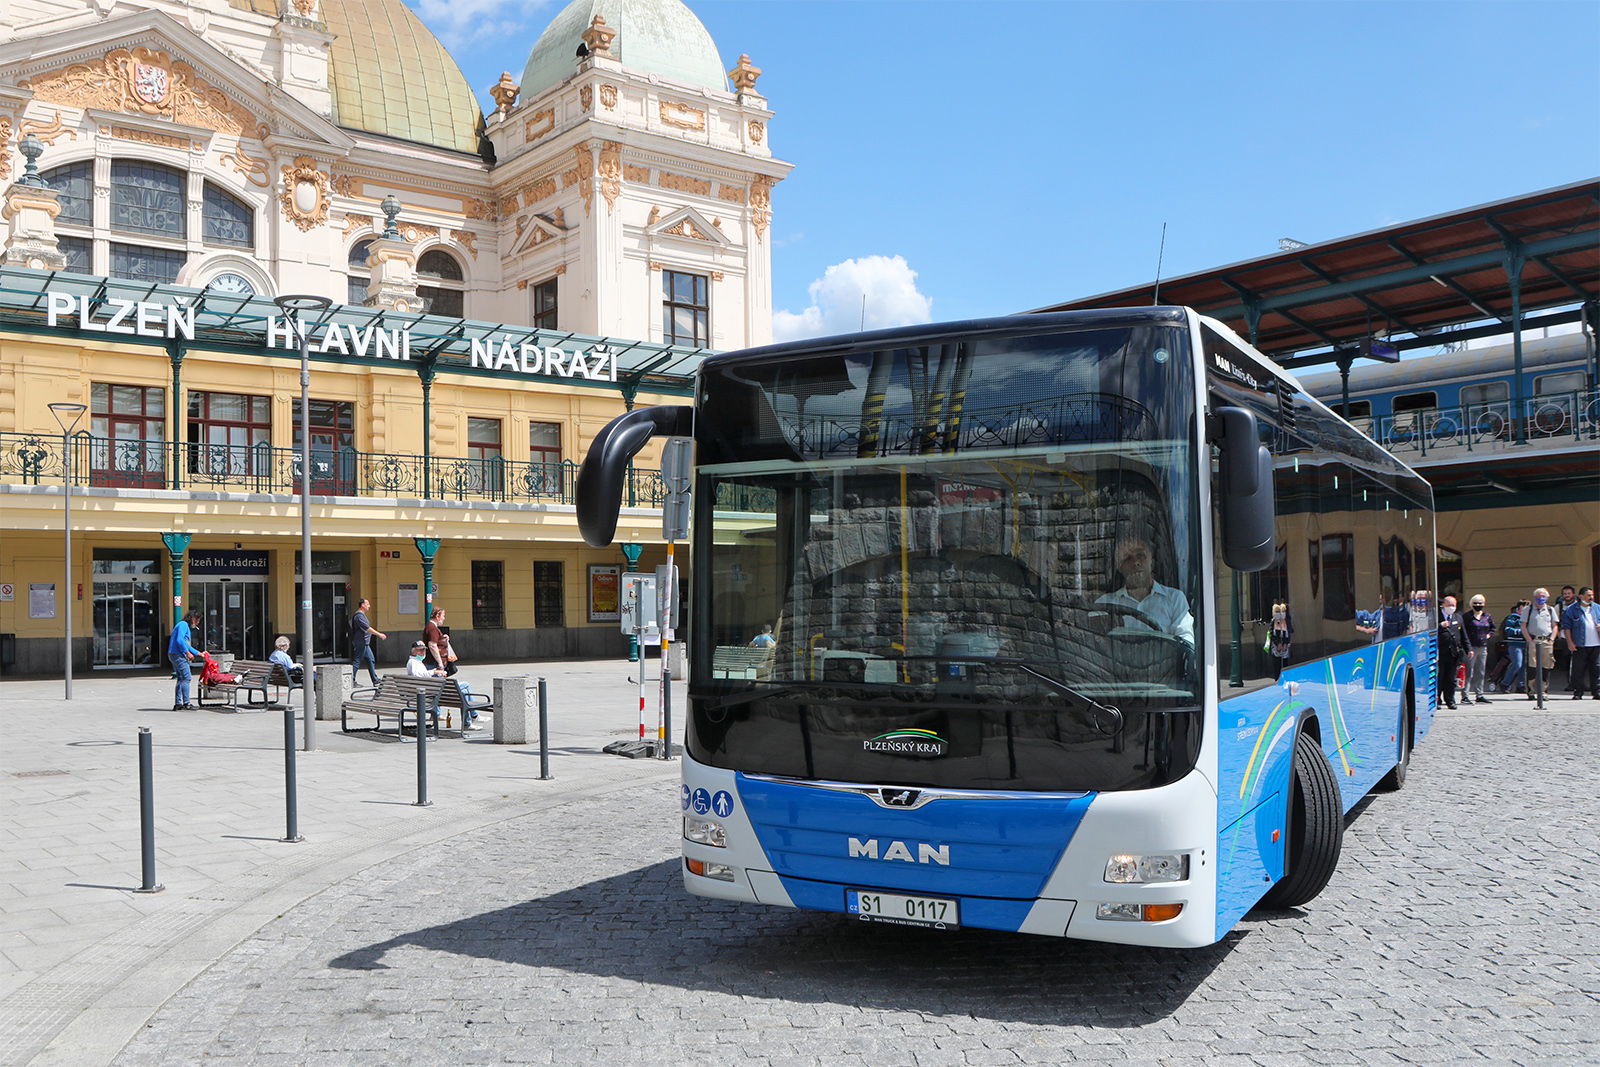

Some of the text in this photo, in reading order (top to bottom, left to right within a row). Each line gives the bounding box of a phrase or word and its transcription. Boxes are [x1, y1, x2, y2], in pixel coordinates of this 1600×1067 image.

[47, 291, 618, 382] PLZEŇ HLAVNÍ NÁDRAŽÍ
[214, 557, 227, 567] hl.
[229, 557, 267, 567] nádraží
[863, 740, 941, 755] PLZEŇSKÝ KRAJ
[848, 837, 950, 866] MAN
[861, 894, 948, 920] S1 0117
